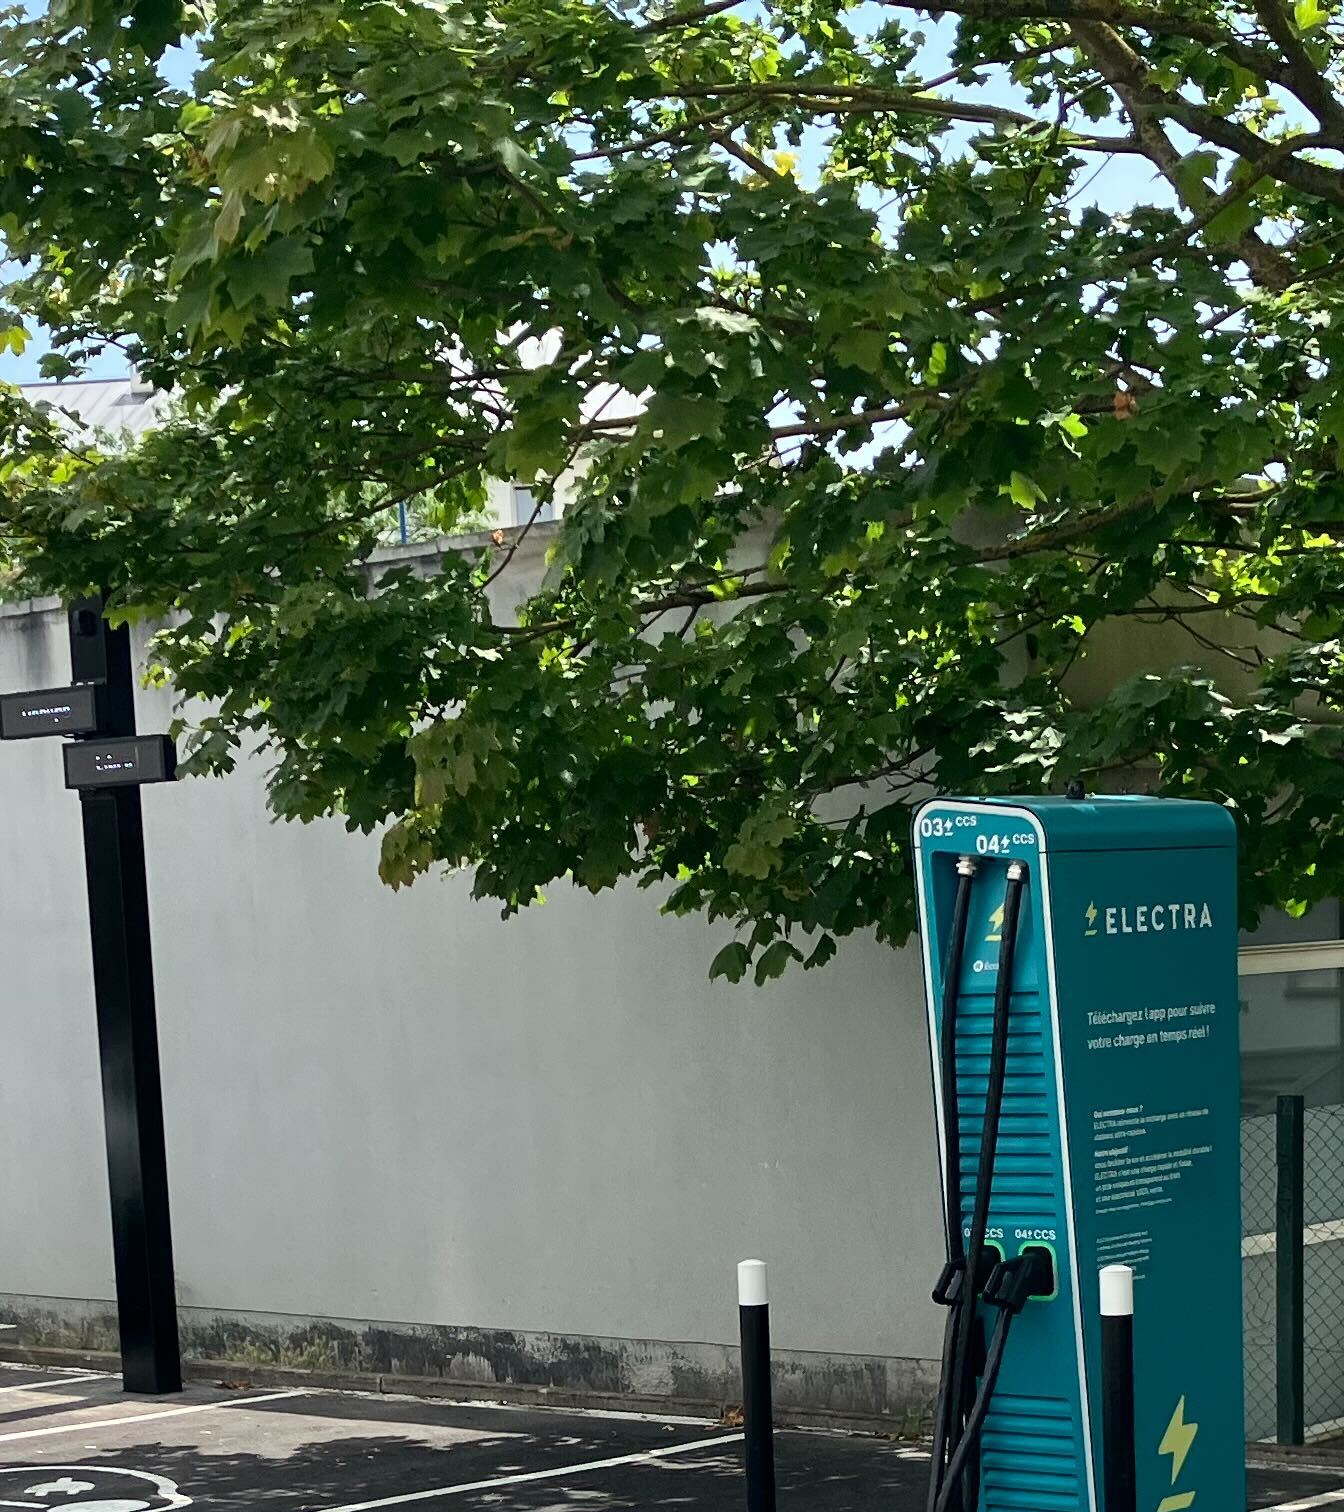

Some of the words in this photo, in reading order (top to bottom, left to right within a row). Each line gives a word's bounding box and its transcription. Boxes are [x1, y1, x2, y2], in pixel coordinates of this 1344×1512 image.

[921, 818, 944, 837] 03
[956, 816, 976, 826] CCS
[976, 835, 1000, 854] 04
[1013, 834, 1035, 844] CCS
[1106, 903, 1213, 934] ELECTRA
[1167, 1007, 1187, 1020] pour
[1189, 1002, 1216, 1016] suivre
[1087, 1036, 1112, 1049] votre
[1112, 1034, 1145, 1048] charge
[1147, 1032, 1157, 1043] en
[1159, 1029, 1187, 1043] temps
[1015, 1229, 1027, 1239] 04
[1034, 1230, 1056, 1240] CCS
